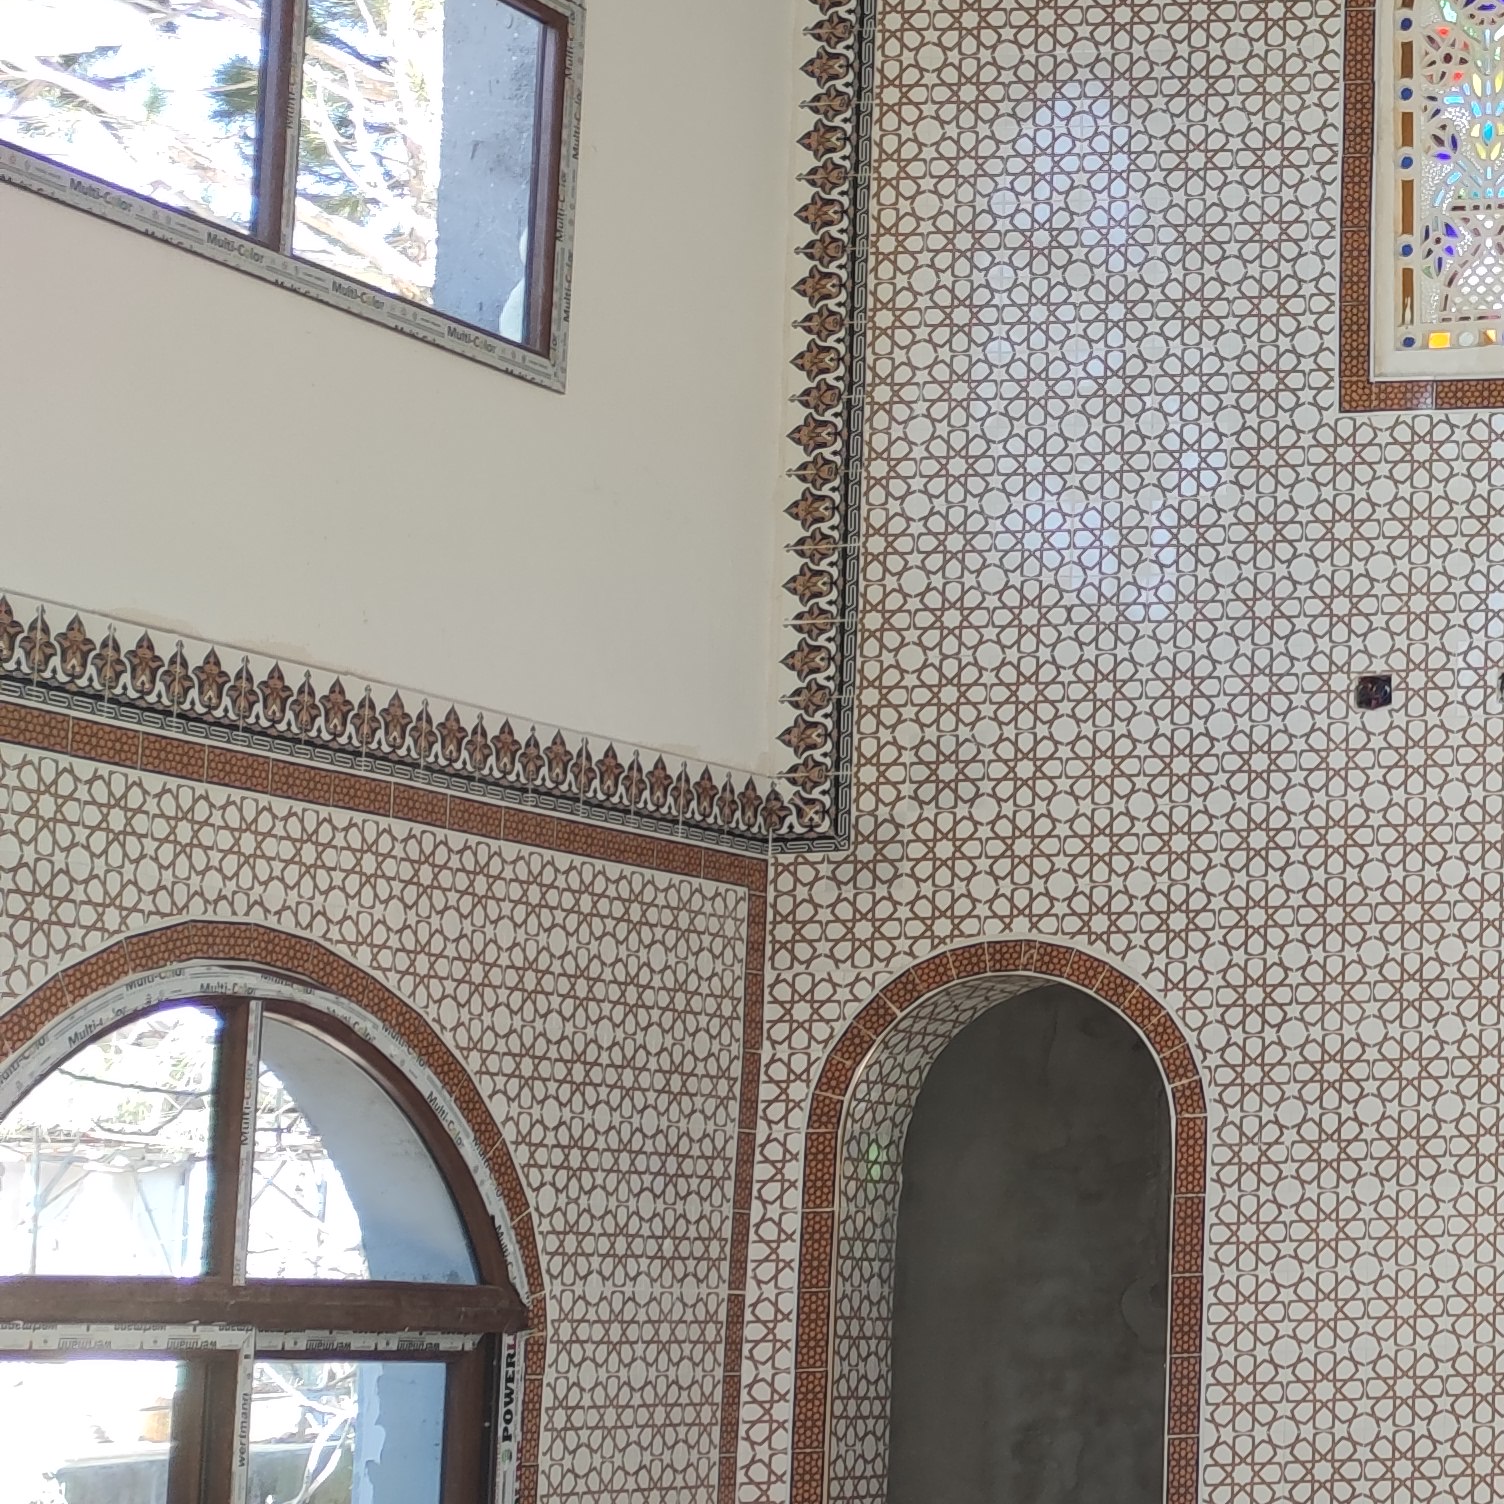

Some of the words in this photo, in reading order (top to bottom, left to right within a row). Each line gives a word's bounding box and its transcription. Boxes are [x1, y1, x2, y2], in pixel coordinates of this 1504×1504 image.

[70, 177, 133, 213] Multi-Color
[206, 231, 266, 266] Multi-Color
[331, 279, 387, 311] Multi-Color
[447, 325, 498, 354] Multi-Color
[501, 1334, 516, 1443] POWERL
[236, 1392, 250, 1468] wertmann
